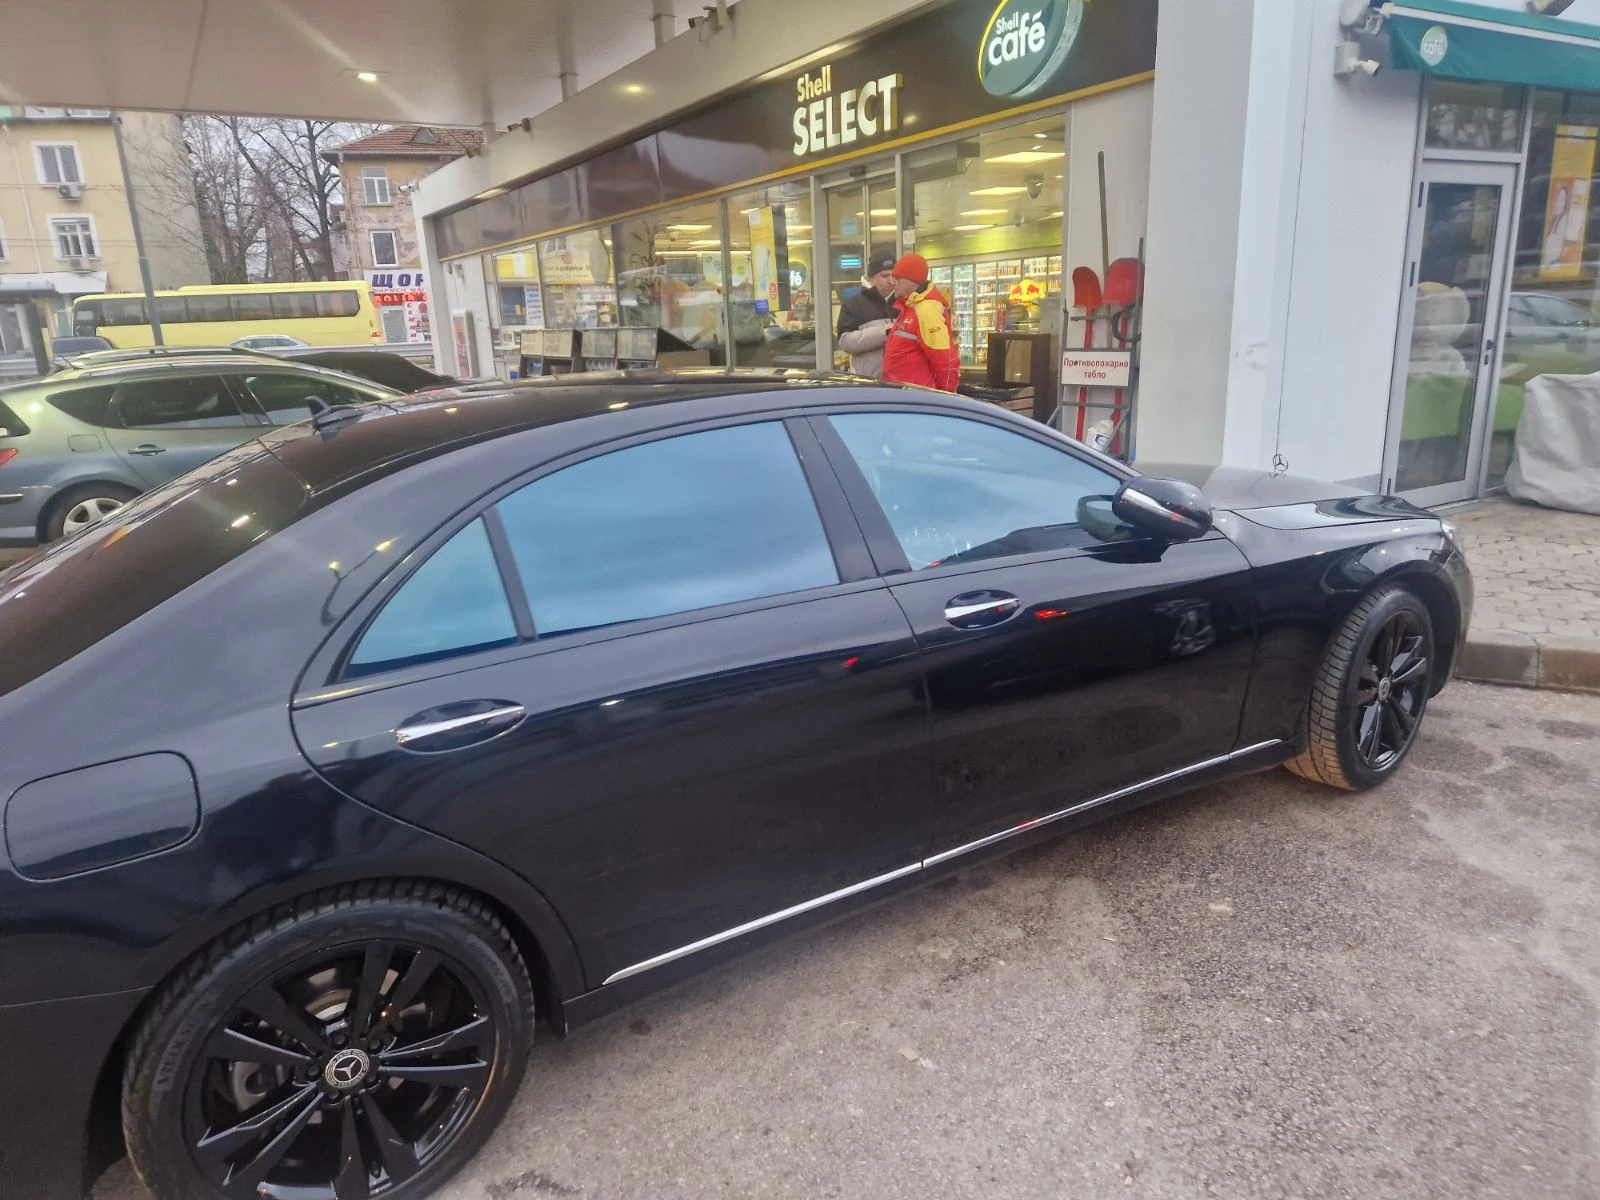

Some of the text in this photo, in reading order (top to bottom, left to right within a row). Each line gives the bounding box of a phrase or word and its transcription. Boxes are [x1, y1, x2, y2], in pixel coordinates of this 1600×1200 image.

[988, 9, 1046, 66] café
[996, 11, 1019, 35] Shell
[797, 64, 832, 102] Shell
[793, 73, 900, 156] SELECT
[1063, 357, 1129, 369] Противопожарно
[1084, 370, 1106, 379] табло
